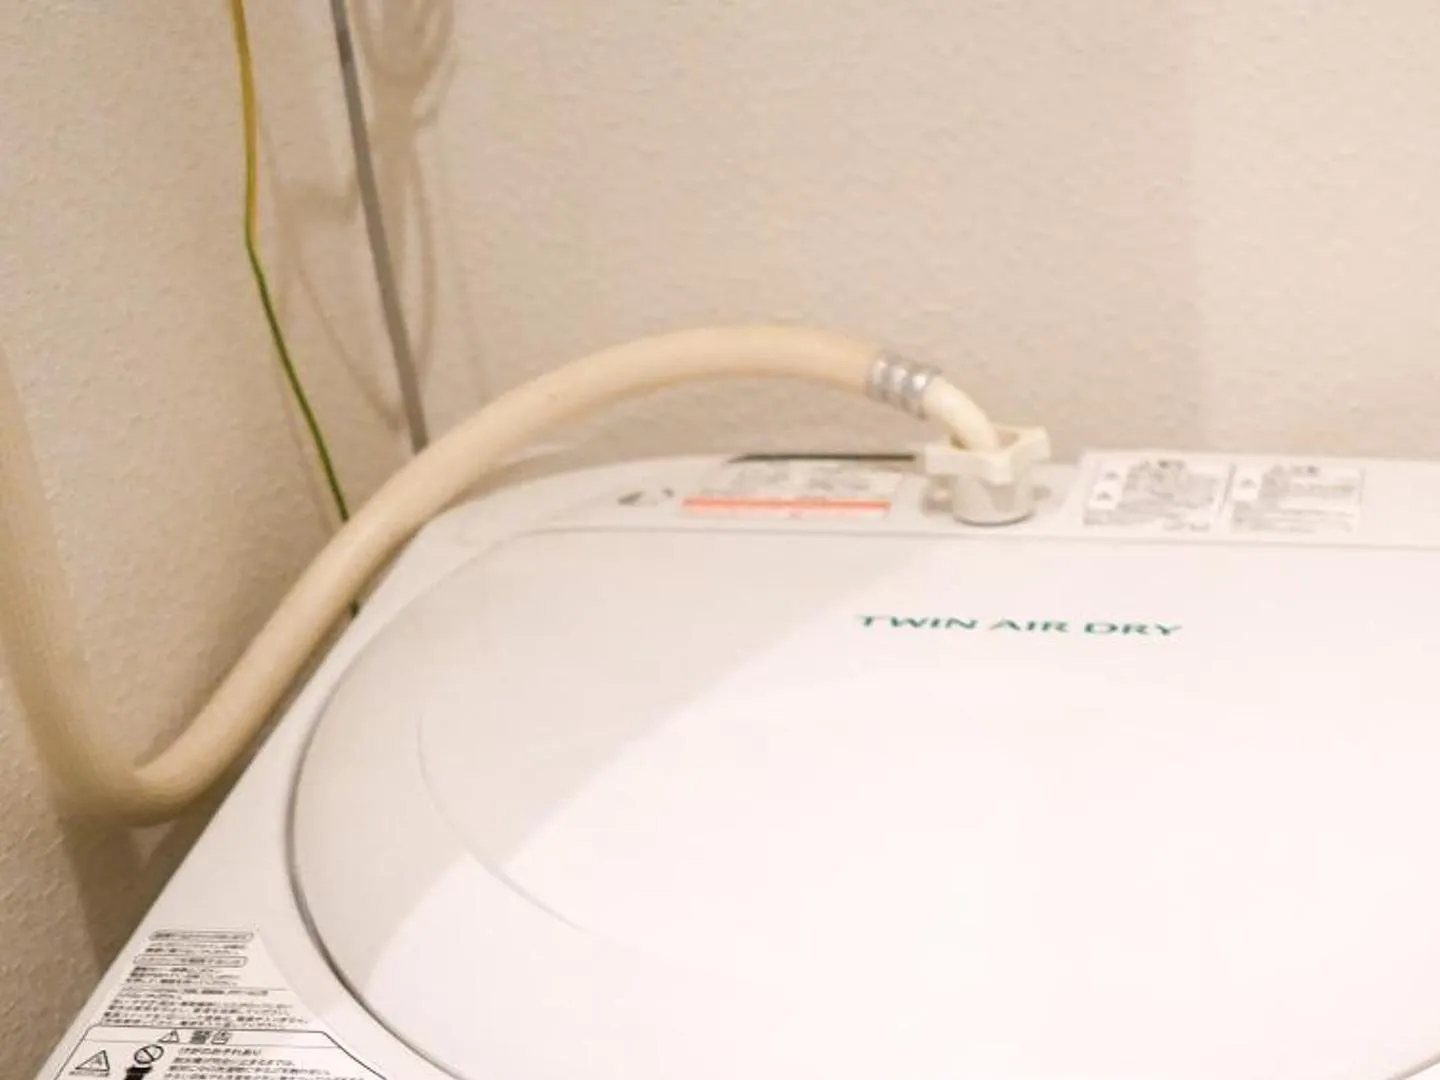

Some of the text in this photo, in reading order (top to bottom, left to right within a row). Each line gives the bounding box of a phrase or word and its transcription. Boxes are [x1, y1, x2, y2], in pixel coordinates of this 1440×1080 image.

[858, 614, 1184, 637] TWIN AIR DRY
